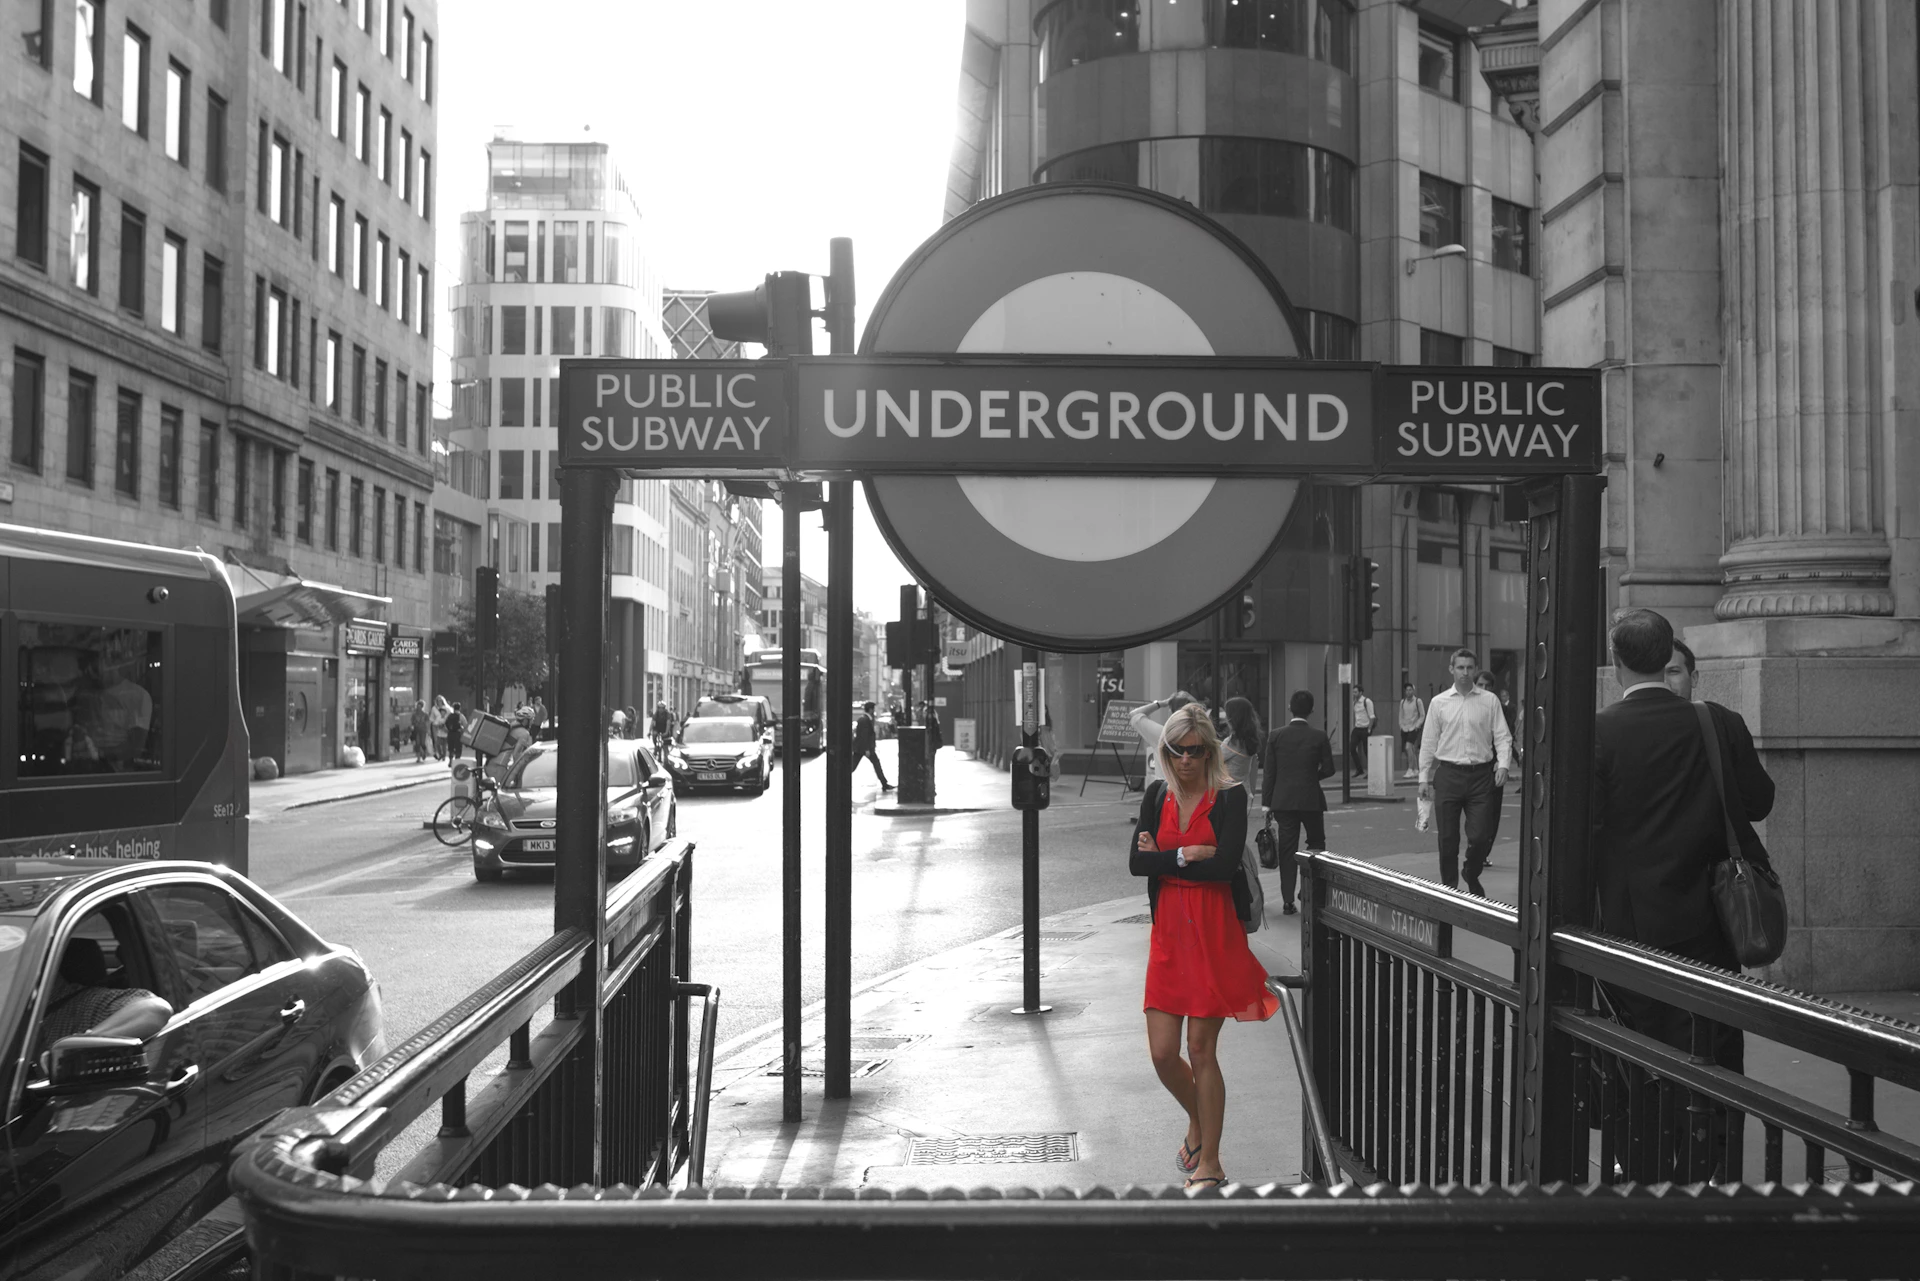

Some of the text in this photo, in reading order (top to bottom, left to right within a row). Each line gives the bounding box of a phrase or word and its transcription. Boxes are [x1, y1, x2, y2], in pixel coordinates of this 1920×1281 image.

[595, 373, 756, 409] PUBLIC
[1410, 380, 1566, 417] PUBLIC
[823, 388, 1349, 442] UNDERGROUND
[580, 415, 771, 452] SUBWAY
[1396, 421, 1580, 458] SUBWAY
[391, 647, 419, 655] GALORE
[948, 646, 967, 657] itsu
[1025, 680, 1034, 703] butts
[213, 803, 234, 818] SEe12
[116, 837, 161, 860] helping
[530, 840, 550, 850] MK13
[1331, 888, 1433, 946] MONUMENT STATION
